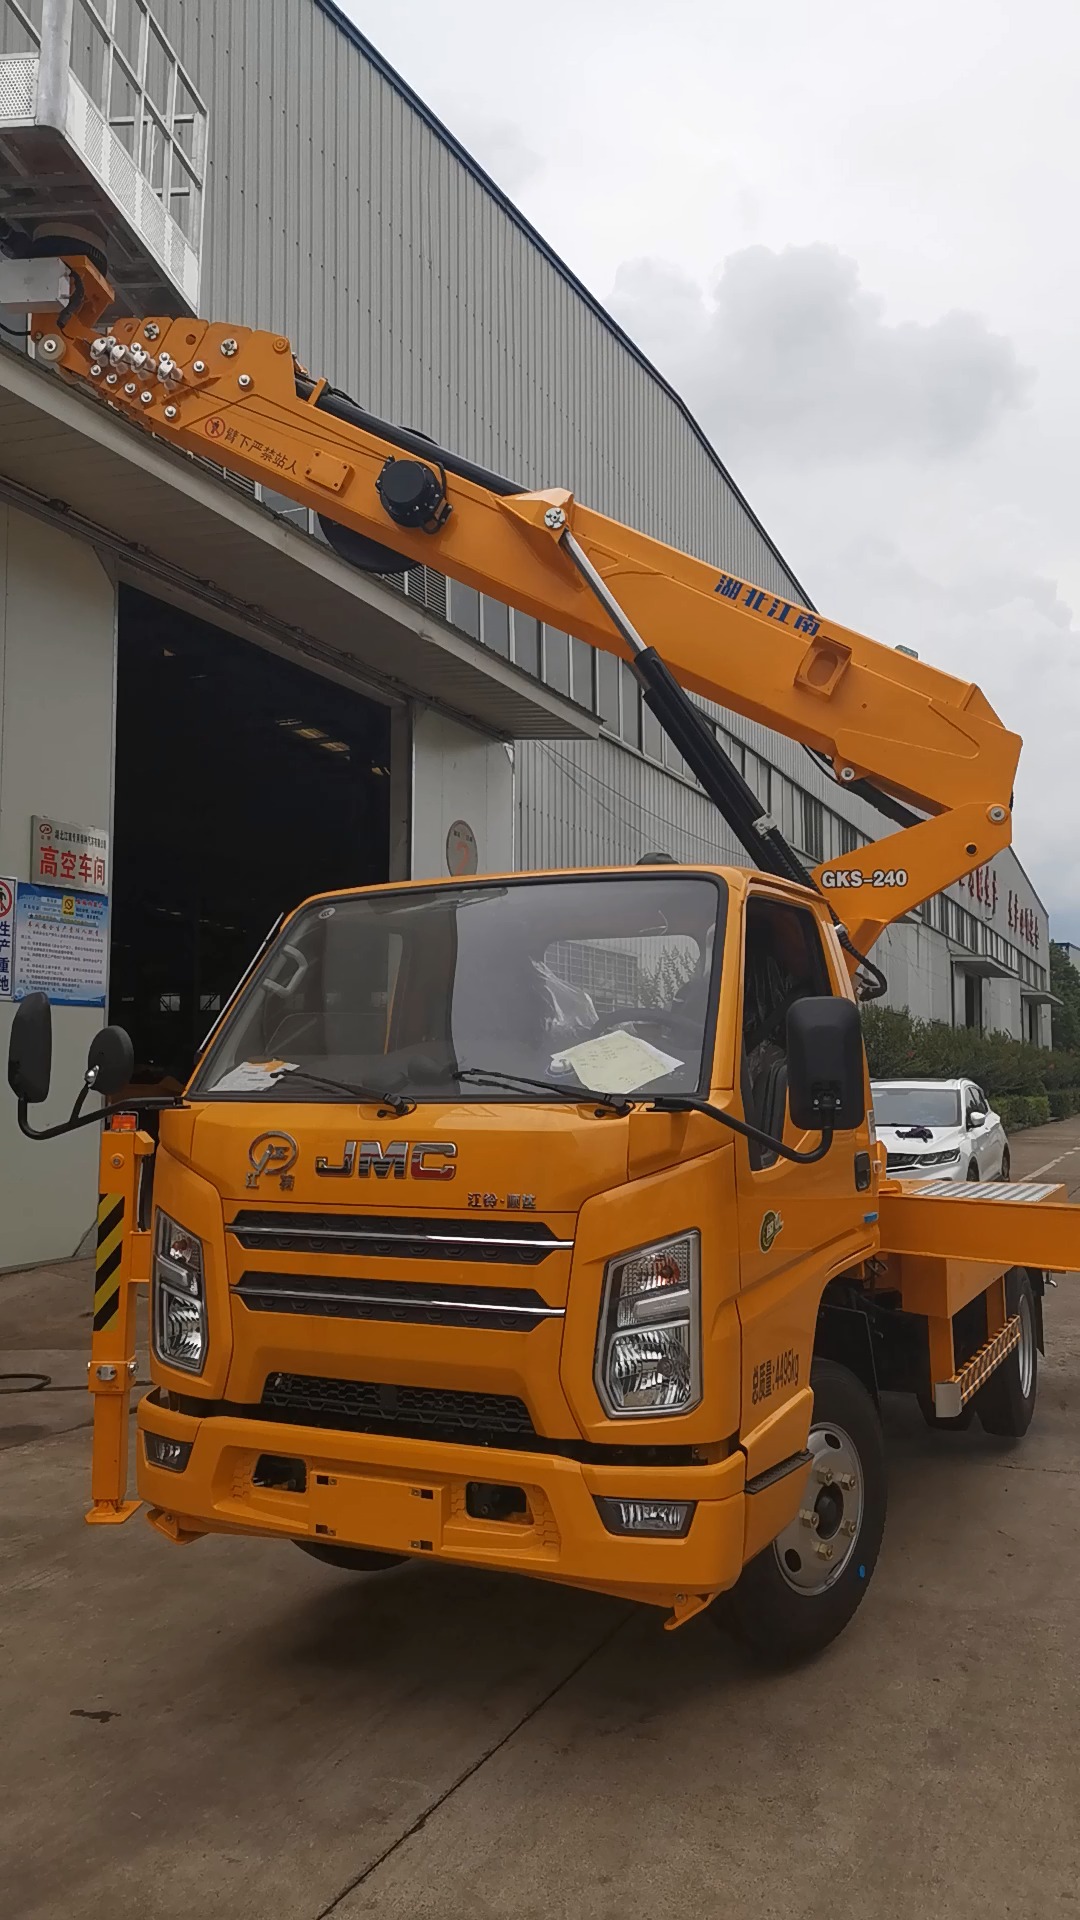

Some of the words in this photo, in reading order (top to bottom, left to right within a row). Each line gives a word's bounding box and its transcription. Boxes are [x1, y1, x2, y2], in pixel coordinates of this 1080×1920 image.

[224, 427, 297, 476] 臂下严禁站人
[714, 574, 822, 637] 湖北江南
[40, 845, 106, 887] 高空车间
[821, 869, 908, 888] GKS-240
[315, 1139, 458, 1180] JMC
